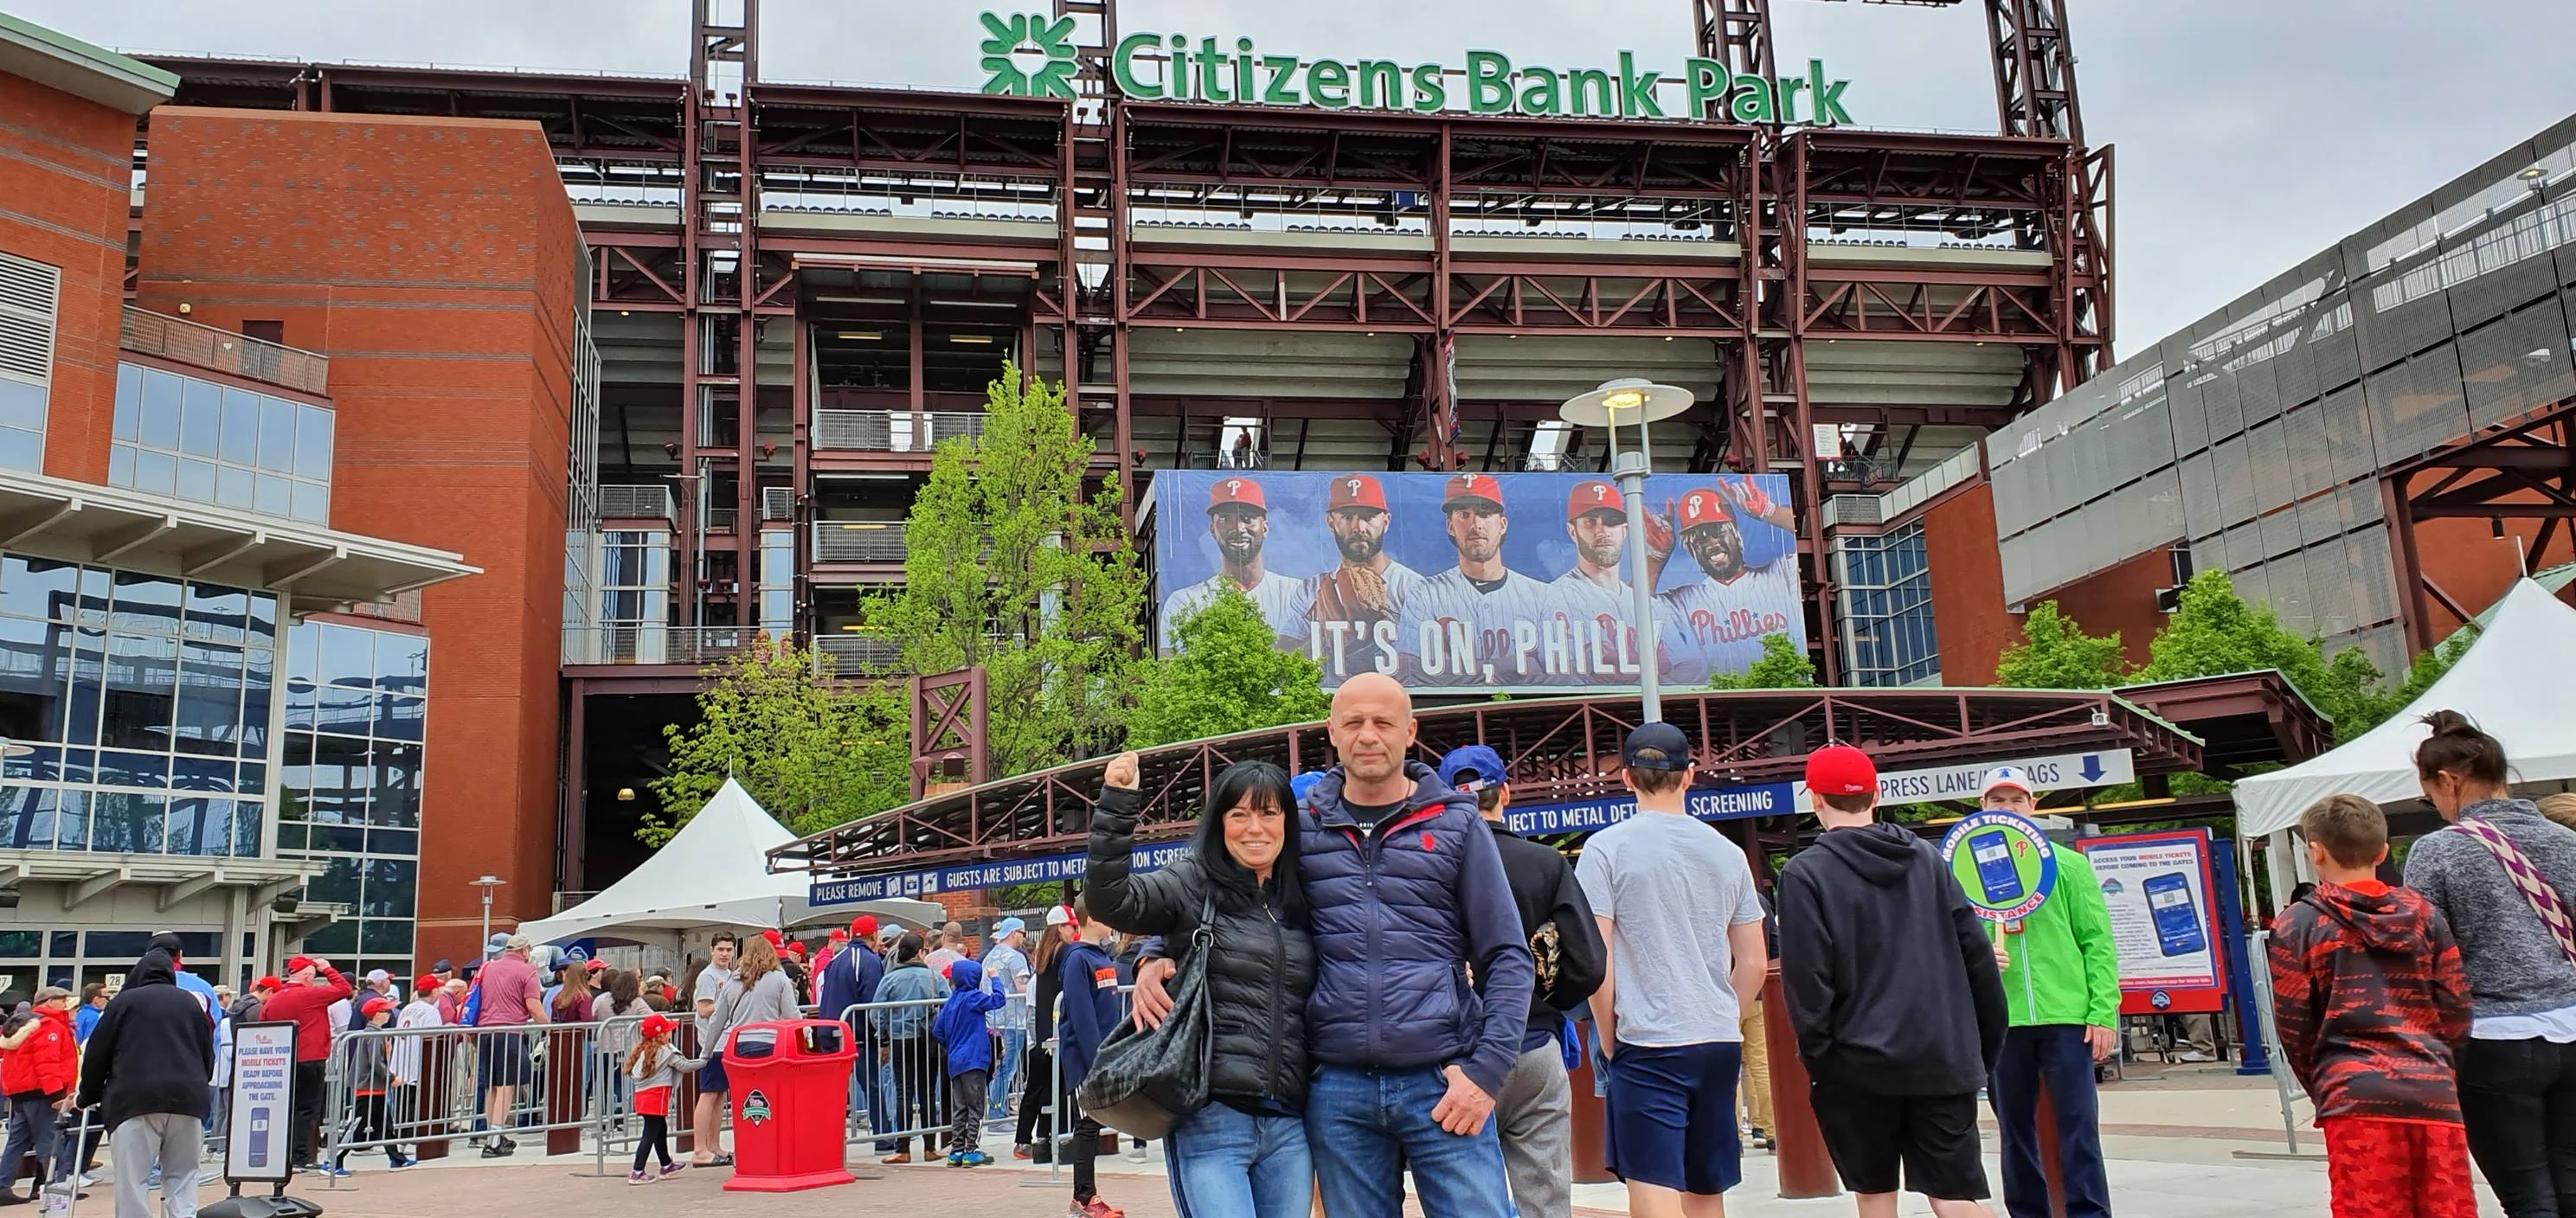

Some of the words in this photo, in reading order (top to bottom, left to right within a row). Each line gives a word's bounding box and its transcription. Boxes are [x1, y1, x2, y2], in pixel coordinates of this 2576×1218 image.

[1113, 31, 1445, 114] Citizens
[1466, 48, 1668, 120] Bank
[1686, 56, 1857, 128] Park
[1227, 480, 1242, 497] P
[1346, 478, 1362, 497] P
[1461, 473, 1477, 489] P
[1592, 484, 1607, 501] P
[1687, 494, 1703, 519] P
[1690, 608, 1789, 646] Phillies
[1310, 620, 1400, 676] IT'S
[1419, 619, 1495, 685] ON,
[1881, 775, 1930, 798] PRESS
[1936, 769, 1988, 793] LANE/
[2027, 763, 2059, 784] AGS
[1502, 812, 1537, 831] JECT
[1540, 810, 1558, 829] TO
[1562, 805, 1607, 826] METAL
[1691, 790, 1773, 817] SCREENING
[1942, 817, 1981, 862] MOBILE
[1982, 814, 2051, 859] TICKETING
[2015, 841, 2028, 858] P
[816, 884, 845, 901] PLEASE
[848, 880, 883, 899] REMOVE
[947, 869, 980, 888] GUESTS
[983, 867, 1001, 884] ARE
[1004, 862, 1044, 881] SUBJECT
[1047, 861, 1059, 877] TO
[1062, 857, 1086, 875] META
[1973, 892, 2046, 920] SISTANCE
[109, 976, 121, 986] 28
[239, 1047, 258, 1055] PLEASE
[241, 1058, 261, 1067] MOBILE
[263, 1057, 286, 1066] TICKETS
[261, 1069, 283, 1078] BEFORE
[242, 1080, 283, 1089] APPROACHING
